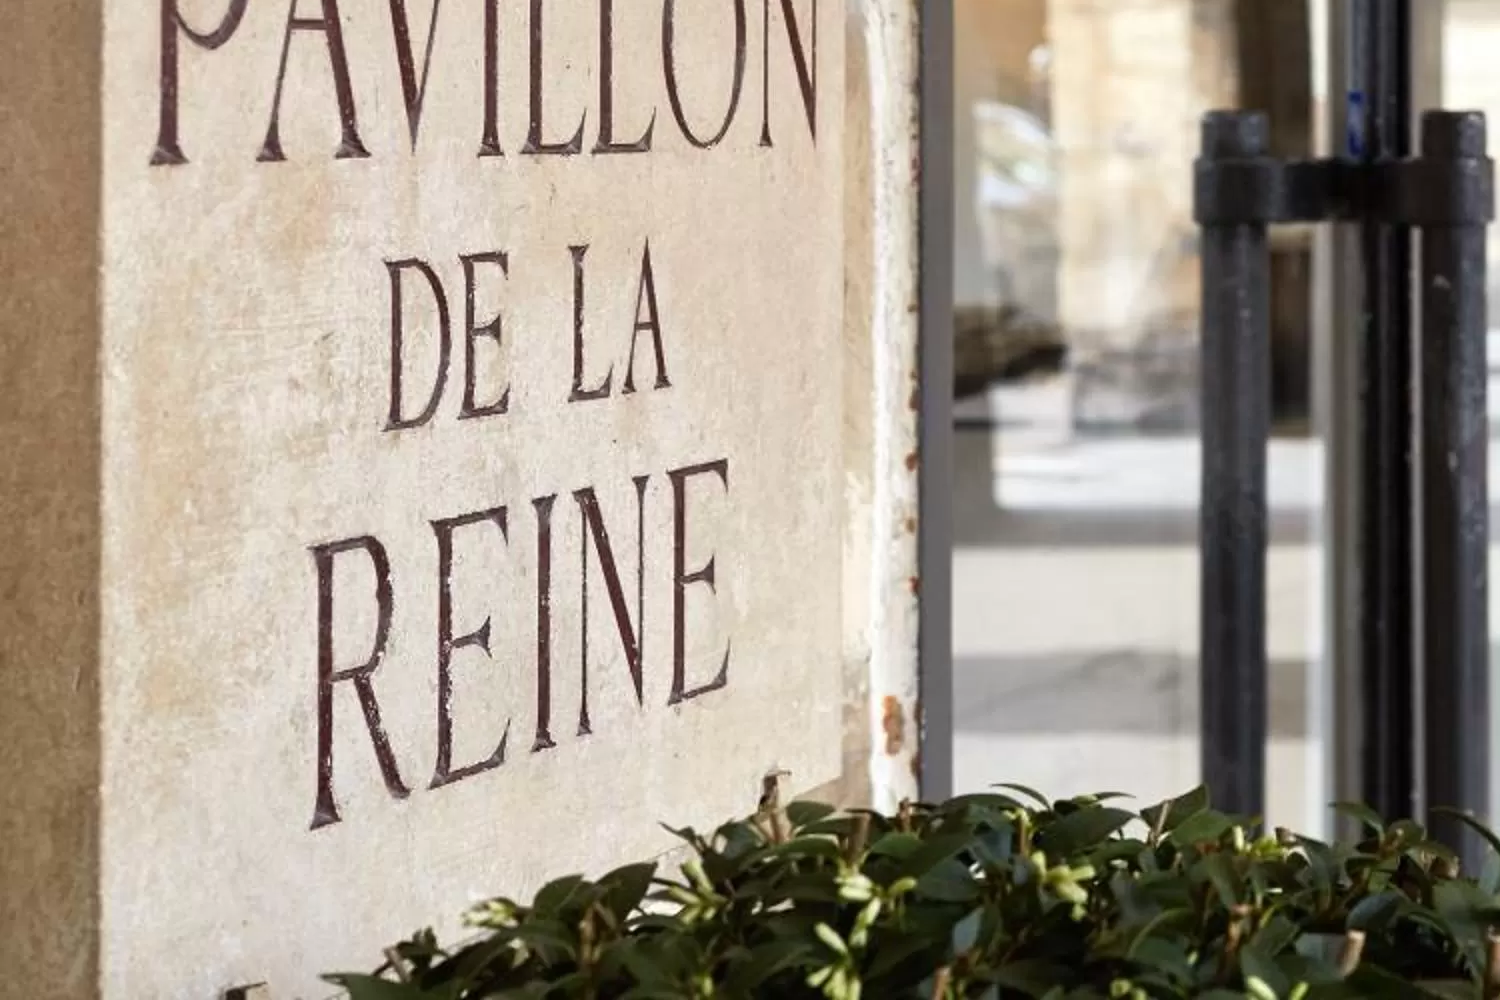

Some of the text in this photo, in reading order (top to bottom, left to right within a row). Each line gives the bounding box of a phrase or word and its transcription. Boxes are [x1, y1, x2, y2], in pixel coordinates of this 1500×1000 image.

[381, 236, 672, 432] DE LA
[308, 457, 732, 831] REINE
